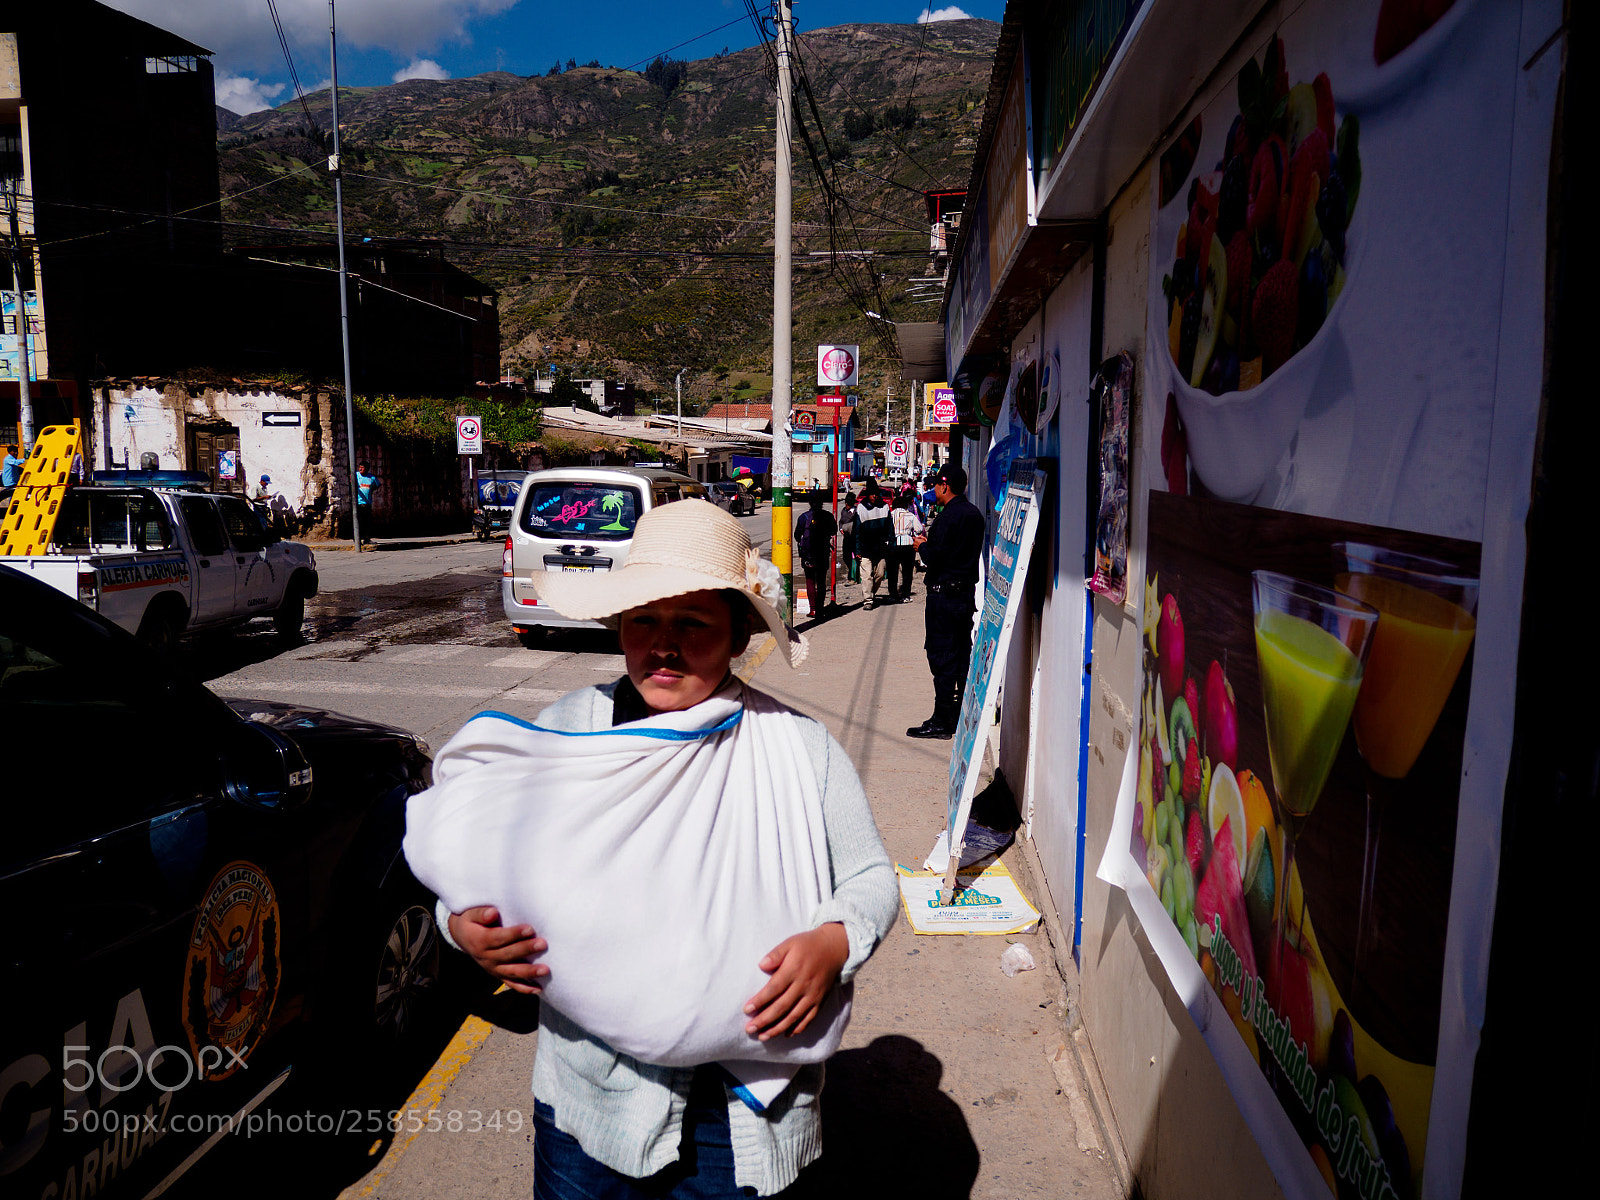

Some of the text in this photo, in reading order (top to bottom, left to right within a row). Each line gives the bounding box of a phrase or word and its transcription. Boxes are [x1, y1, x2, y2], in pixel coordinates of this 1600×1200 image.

[824, 360, 849, 369] Claro
[101, 561, 188, 586] ALERTA CARHUAZ
[196, 870, 270, 940] POLICIA NACIONAL
[217, 896, 233, 917] DEL
[964, 896, 998, 905] MESES
[1210, 913, 1243, 996] Jugos
[1241, 969, 1252, 1021] y
[1253, 976, 1317, 1114] Ensalada
[1317, 1078, 1342, 1153] de
